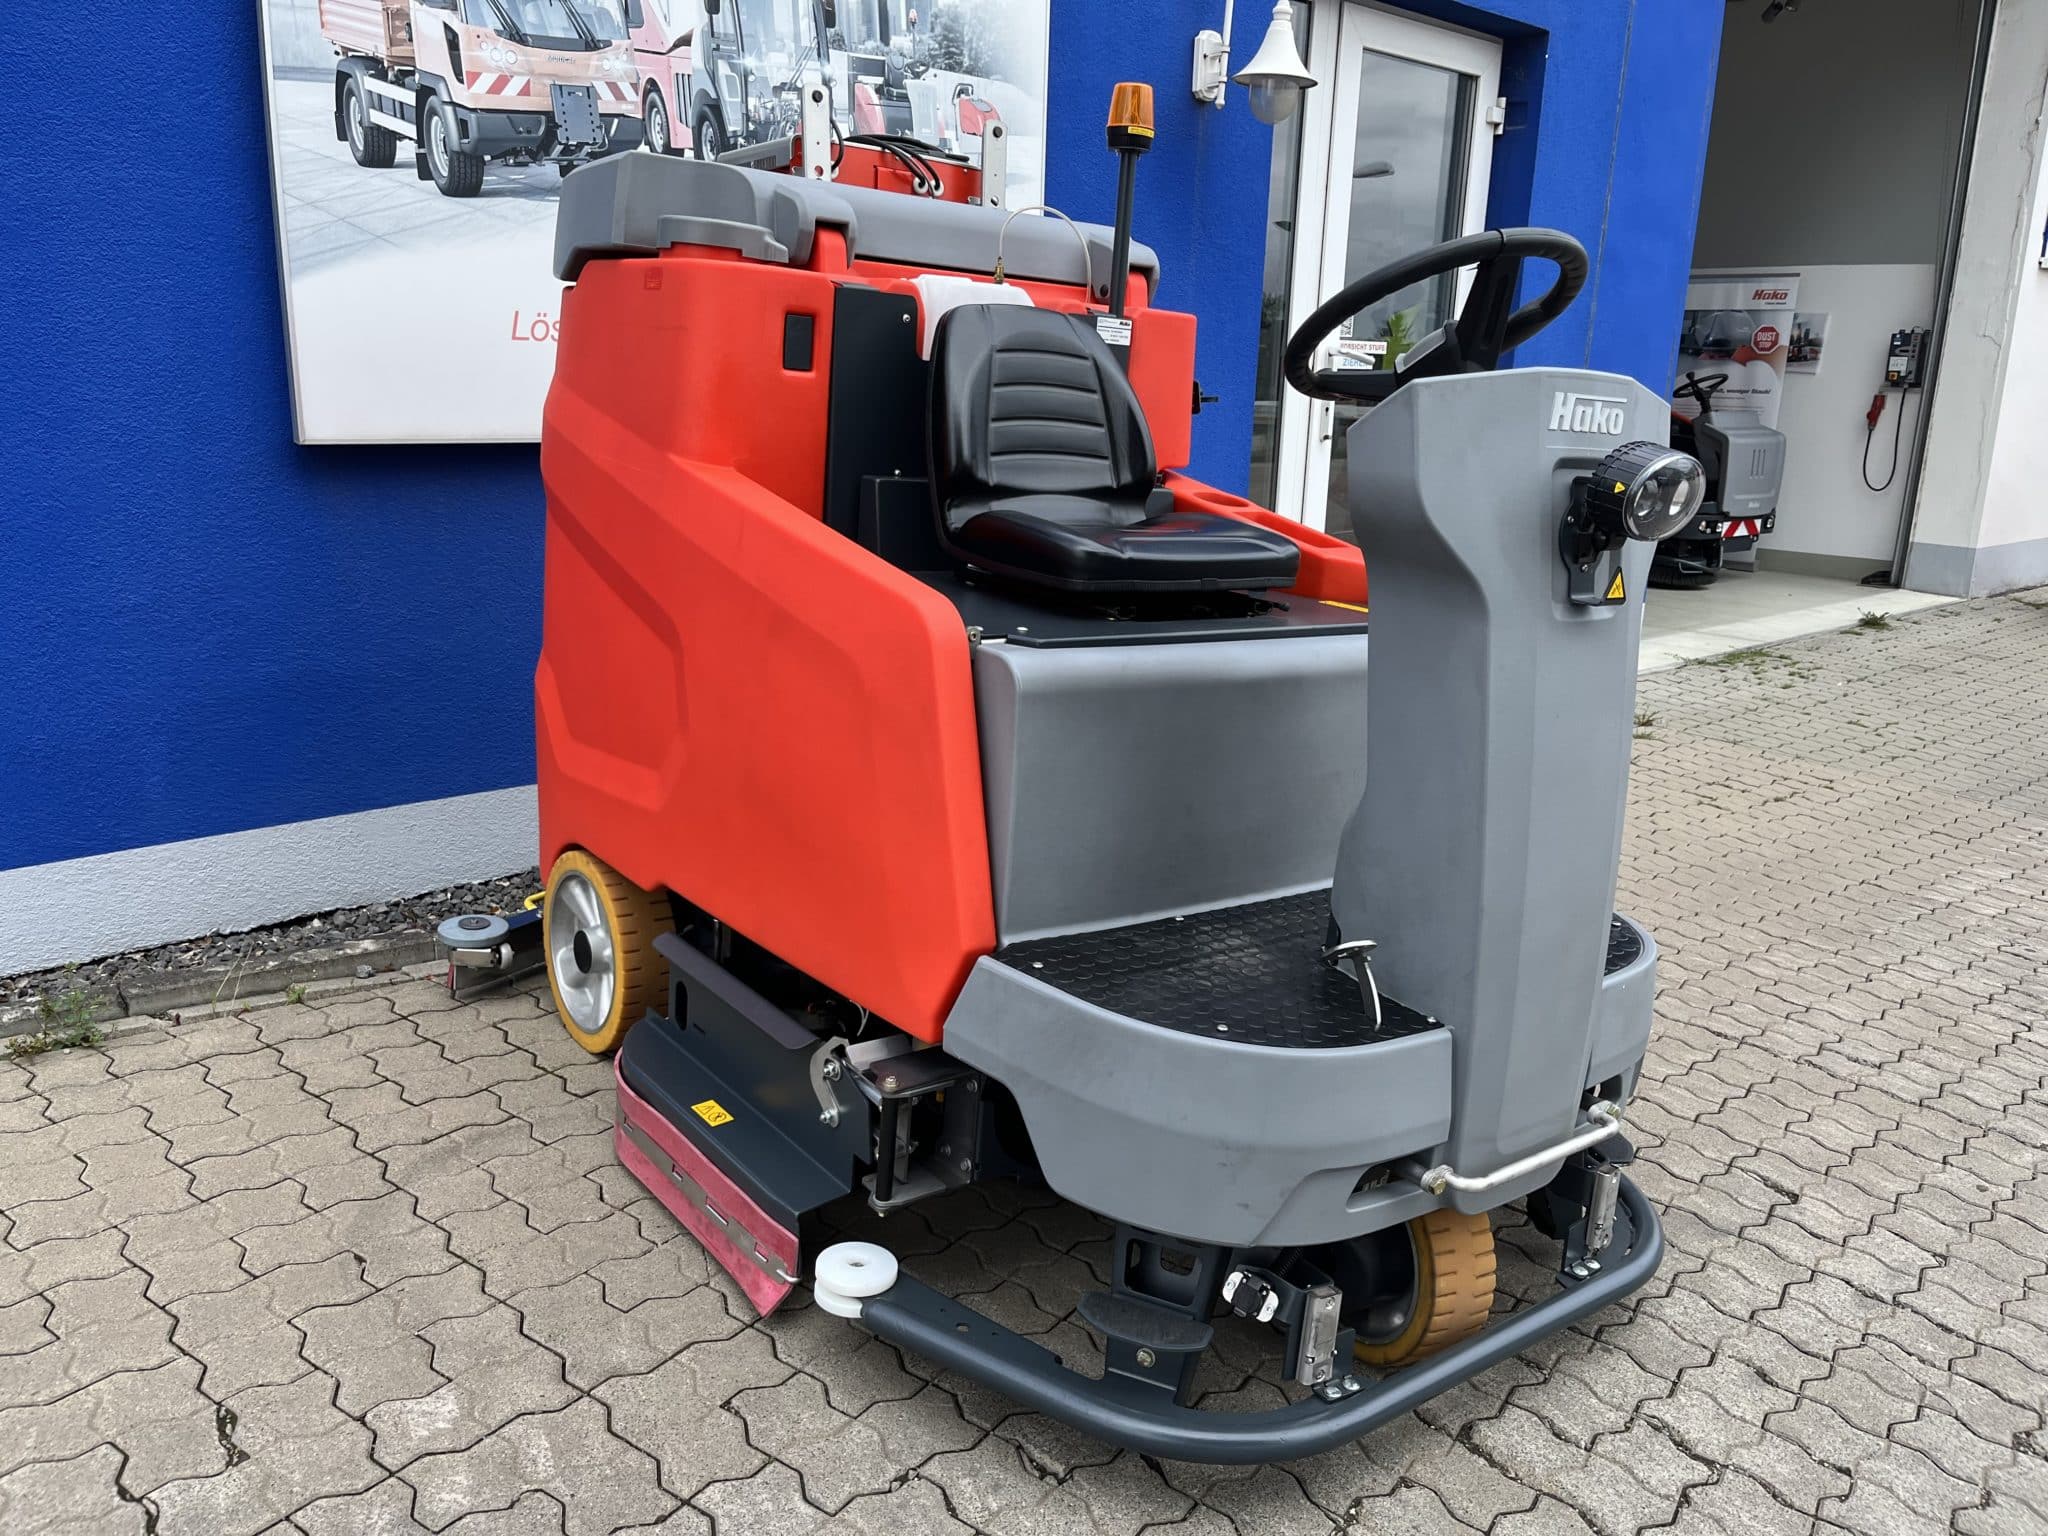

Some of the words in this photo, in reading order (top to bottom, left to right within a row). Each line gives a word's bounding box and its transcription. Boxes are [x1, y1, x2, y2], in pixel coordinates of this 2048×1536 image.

[1752, 288, 1791, 301] Hako
[1756, 331, 1777, 342] DUST
[1547, 391, 1628, 436] Hako
